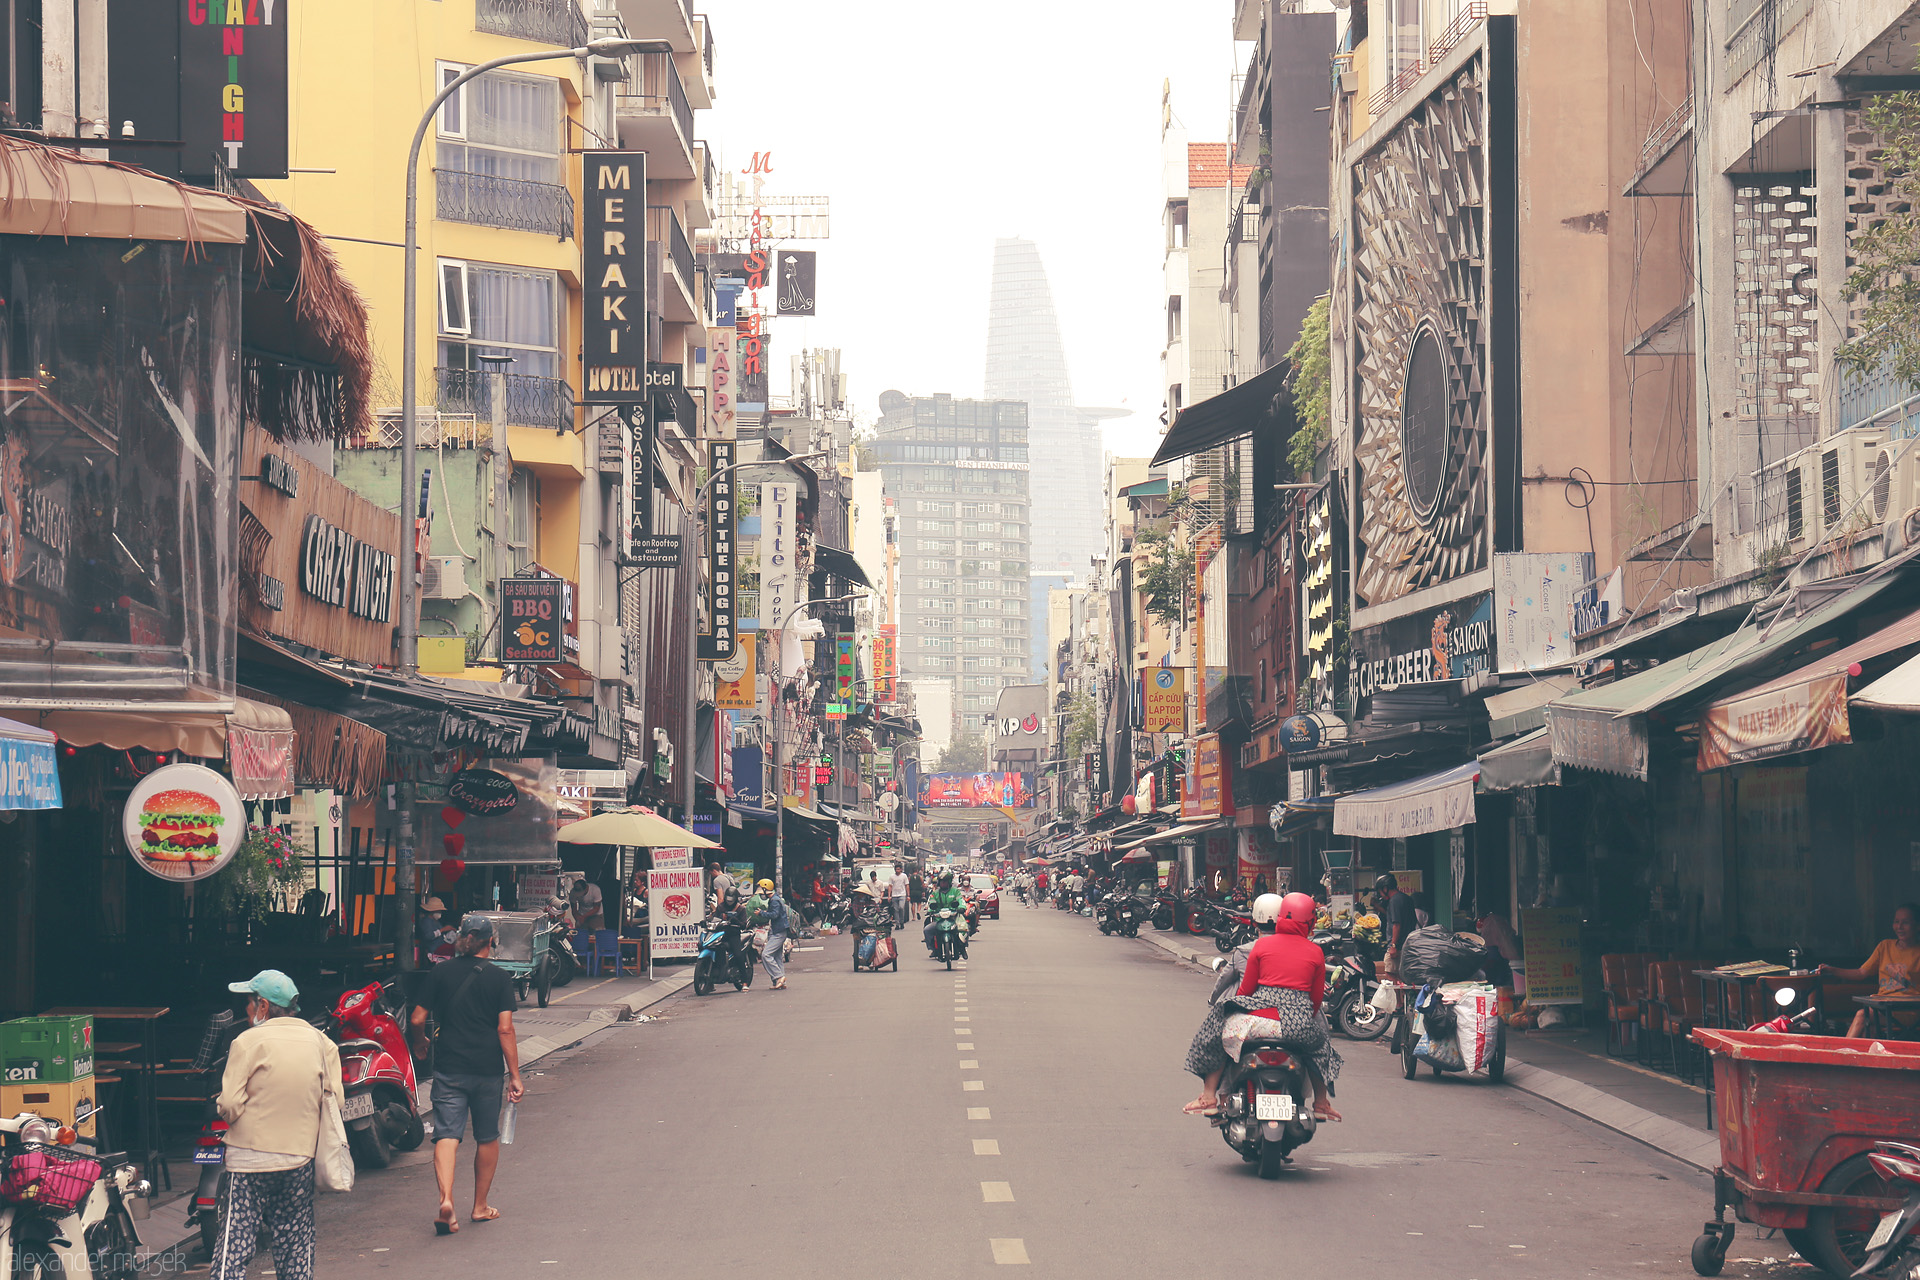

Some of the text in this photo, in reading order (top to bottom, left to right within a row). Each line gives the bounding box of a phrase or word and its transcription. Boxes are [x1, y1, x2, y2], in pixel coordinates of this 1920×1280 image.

[188, 0, 275, 25] CRAZY
[223, 28, 244, 169] NIGHT
[598, 165, 630, 353] MERAKI
[588, 366, 640, 391] HOTEL
[646, 370, 675, 386] otel
[712, 331, 731, 433] HAPPY
[715, 500, 729, 524] OF
[631, 539, 640, 547] afe
[651, 539, 679, 549] Rooftop
[716, 530, 729, 566] THE
[768, 487, 787, 626] Elite Tour
[304, 514, 354, 608] CRAZY
[353, 540, 396, 623] NIGHT
[505, 582, 514, 596] BÀ
[529, 582, 538, 596] BÙI
[715, 572, 729, 609] DOG
[511, 599, 552, 620] BBQ
[715, 614, 729, 651] BAR
[1453, 620, 1488, 656] SAIGON
[506, 647, 556, 658] Seafood
[873, 640, 884, 651] 96
[1360, 660, 1385, 697] CAFE
[1387, 657, 1394, 684] &
[1397, 648, 1431, 684] BEER
[1149, 691, 1164, 703] CẤP
[1149, 706, 1181, 714] LAPTOP
[0, 747, 31, 796] offee
[561, 786, 588, 797] AKI
[740, 787, 760, 802] Tour
[673, 848, 687, 859] SERVICE
[670, 872, 686, 888] CANH
[688, 872, 700, 888] CUA
[656, 923, 698, 936] DÌ NĂM
[1259, 1108, 1290, 1118] 021.00
